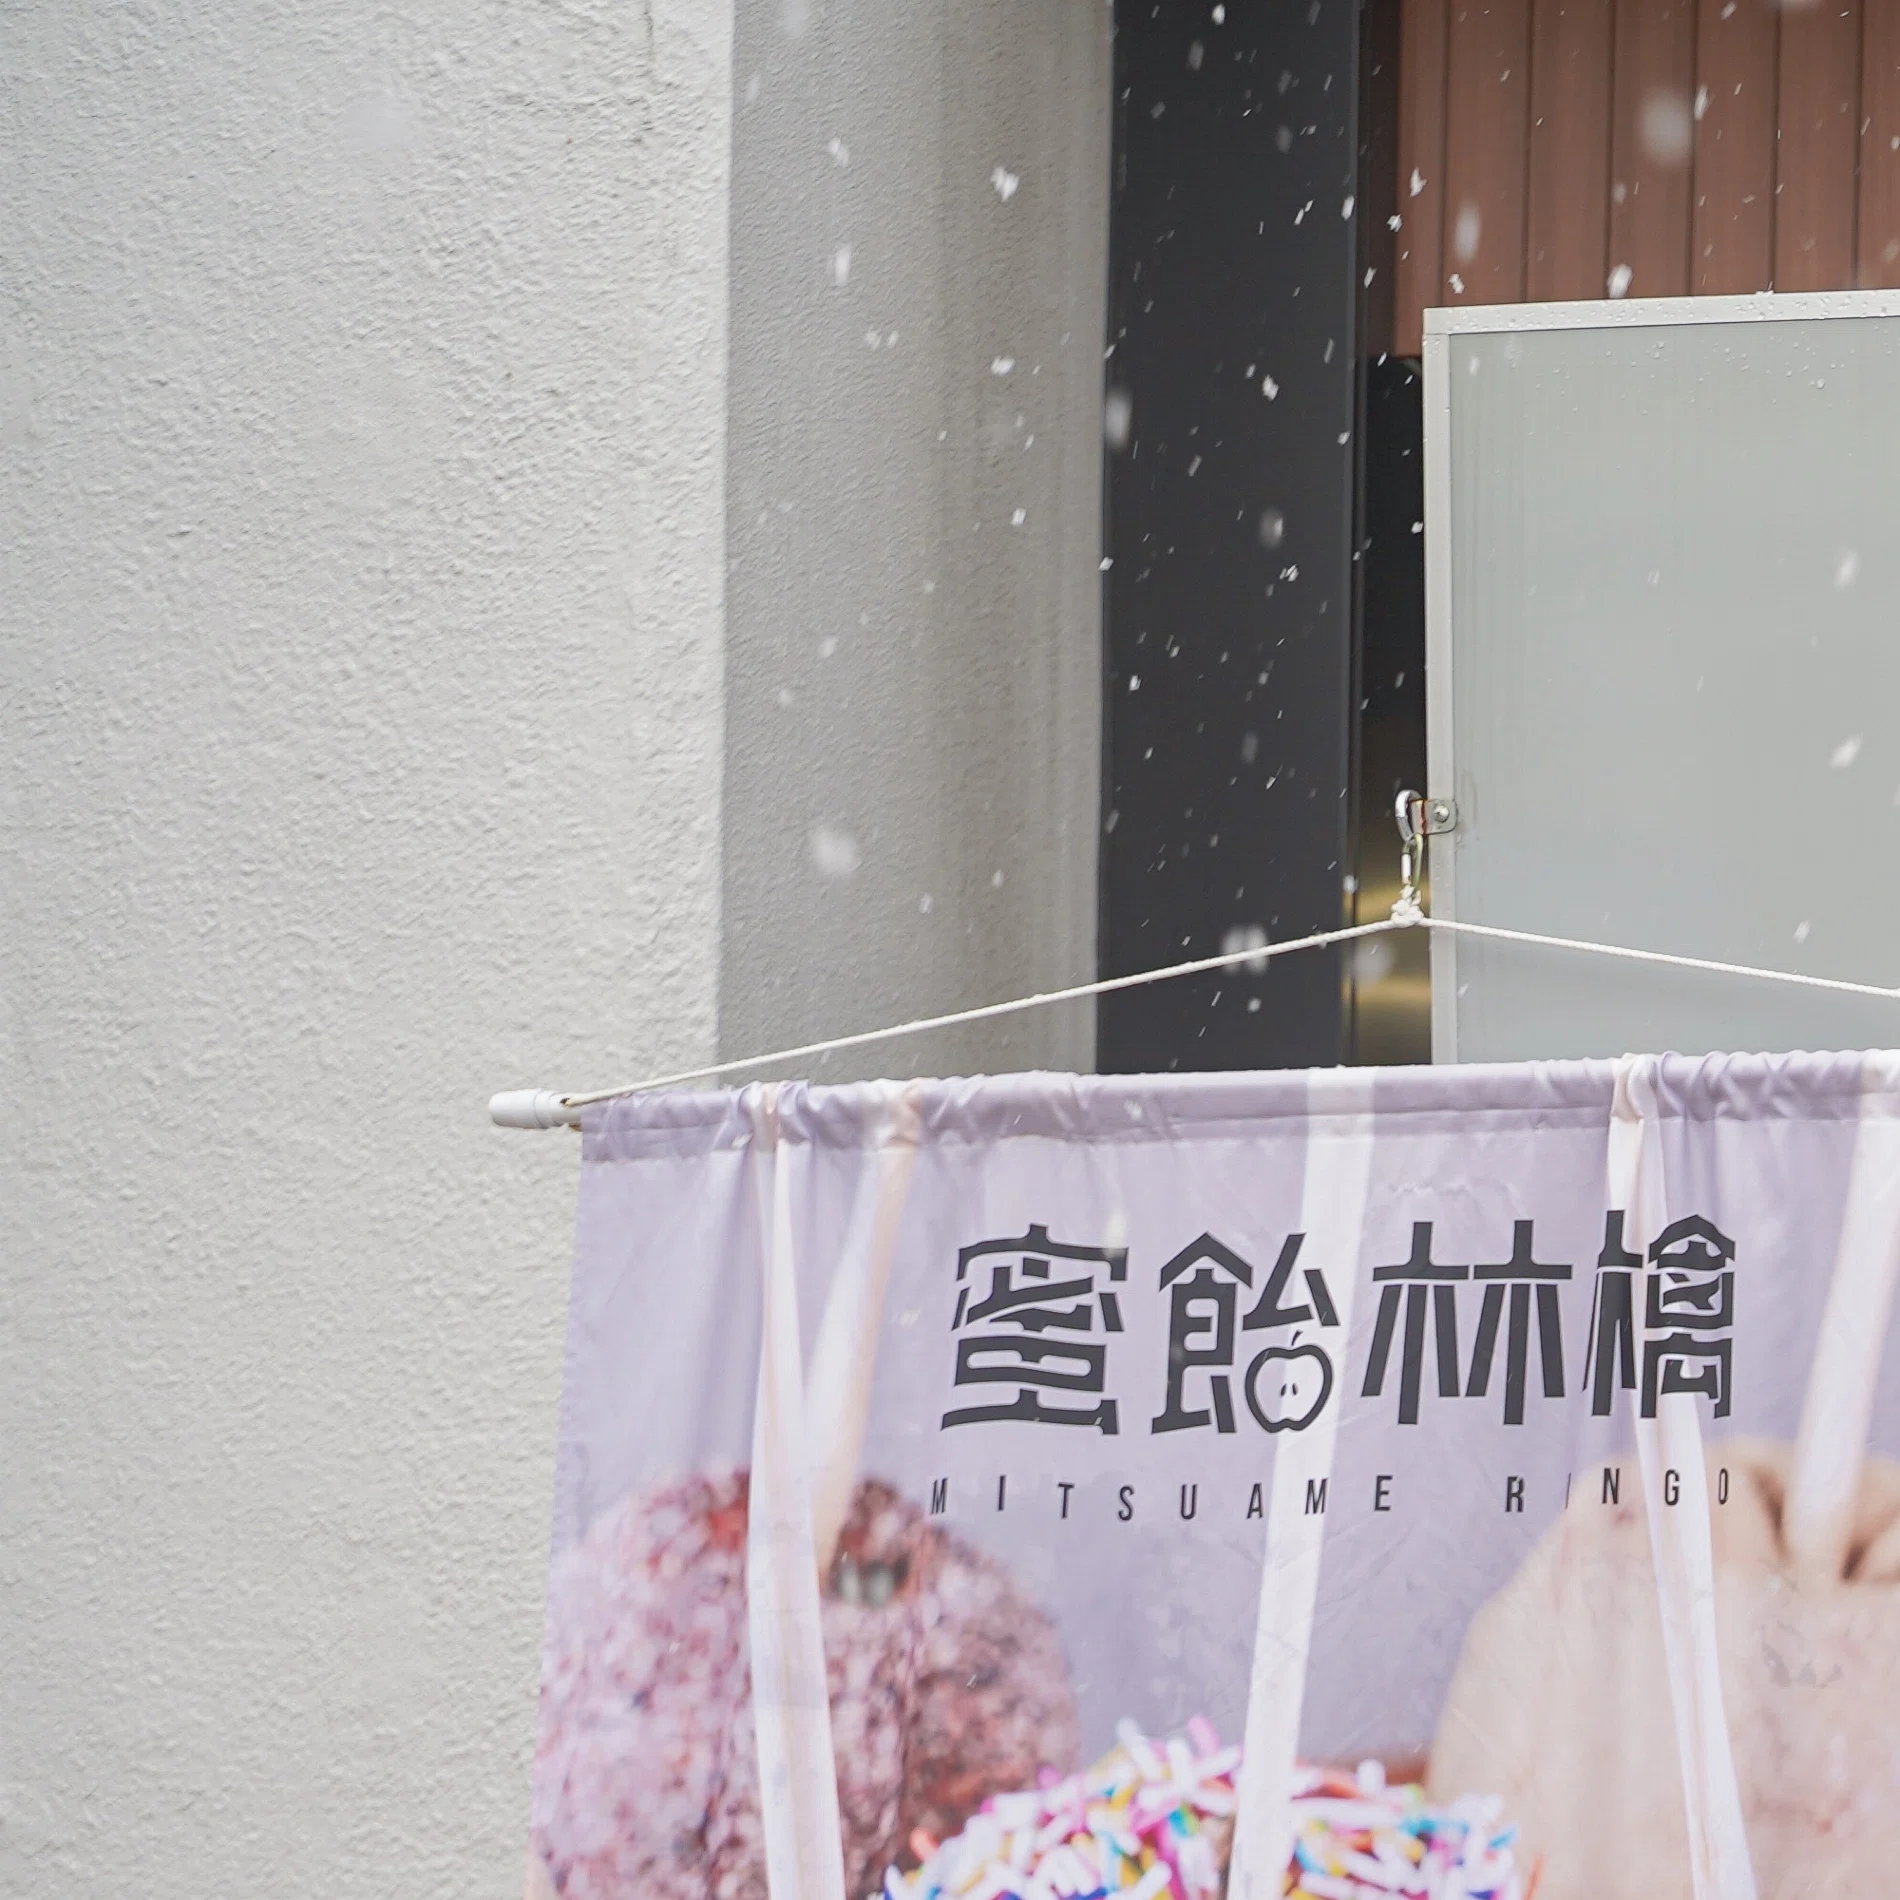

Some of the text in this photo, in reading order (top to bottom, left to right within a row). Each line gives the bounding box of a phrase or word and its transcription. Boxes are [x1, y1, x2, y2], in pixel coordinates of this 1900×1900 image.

[940, 1209, 1736, 1435] 蜜飴林檎
[931, 1467, 1730, 1522] MITSUAME RINGO
